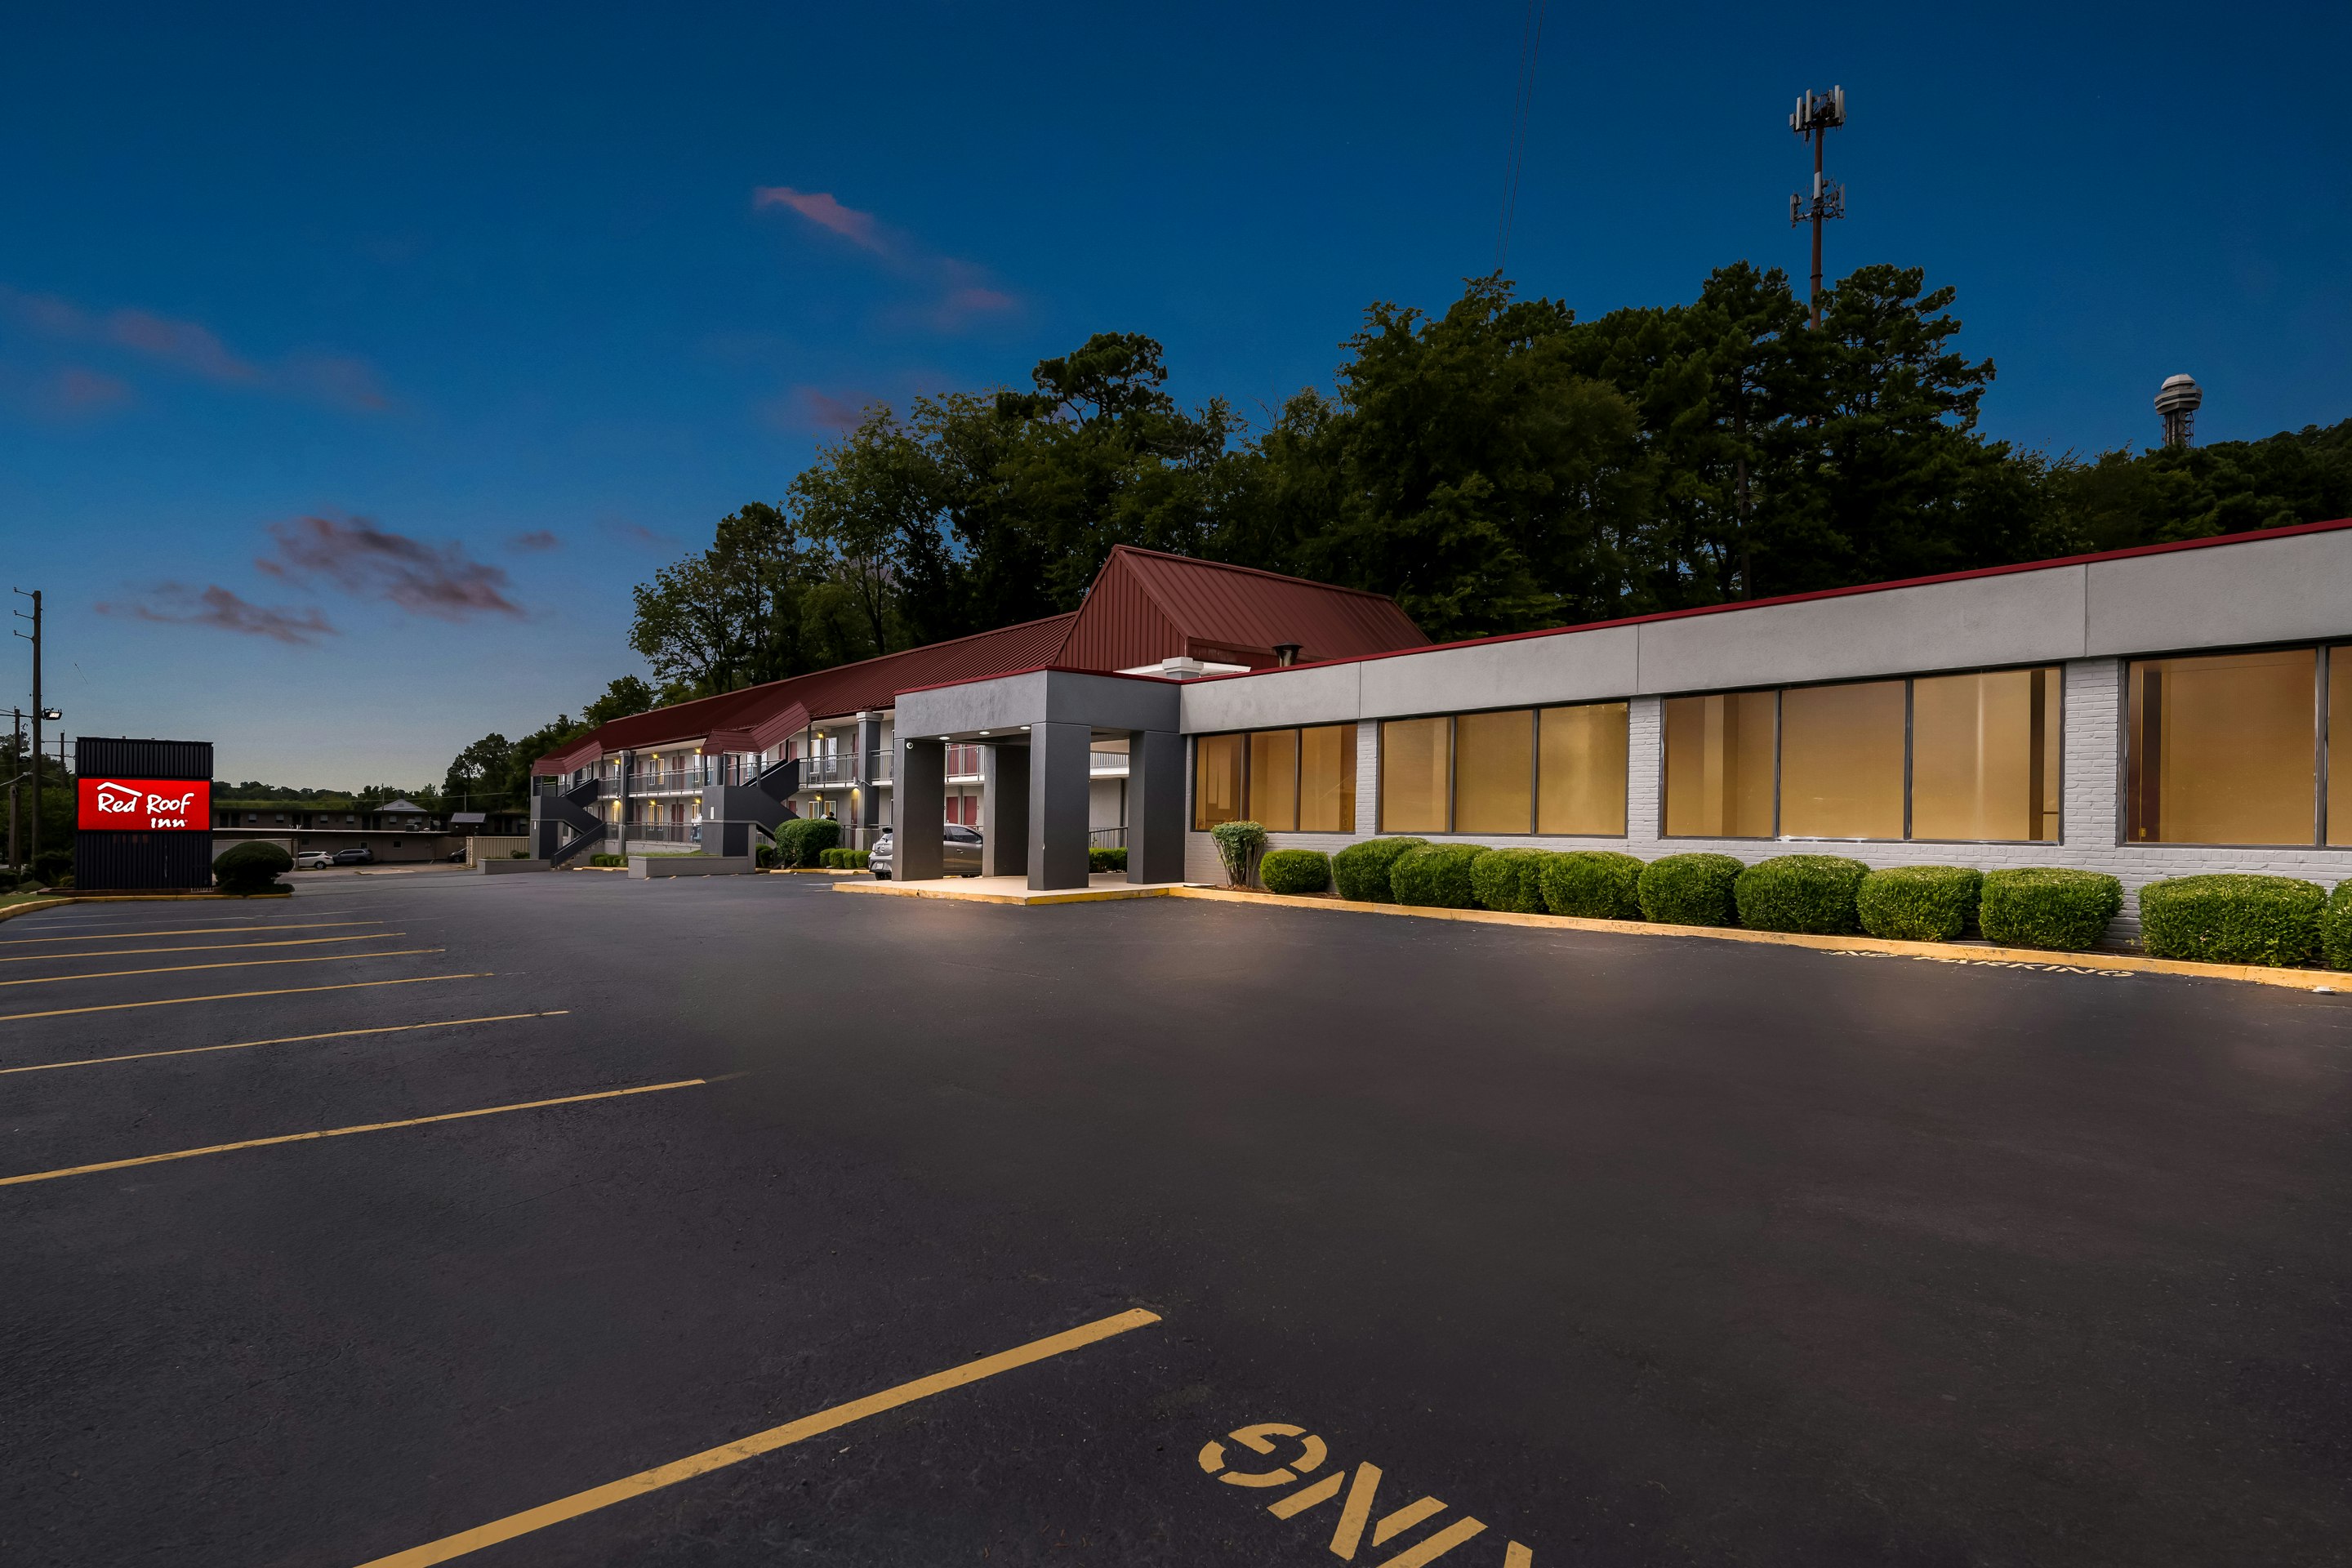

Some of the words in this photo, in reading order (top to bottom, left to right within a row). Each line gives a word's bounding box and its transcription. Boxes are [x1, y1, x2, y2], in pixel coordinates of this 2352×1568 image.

[97, 792, 137, 813] Red
[146, 792, 195, 815] Roof
[1912, 956, 2136, 978] PARKING
[1198, 1422, 1534, 1568] ING
